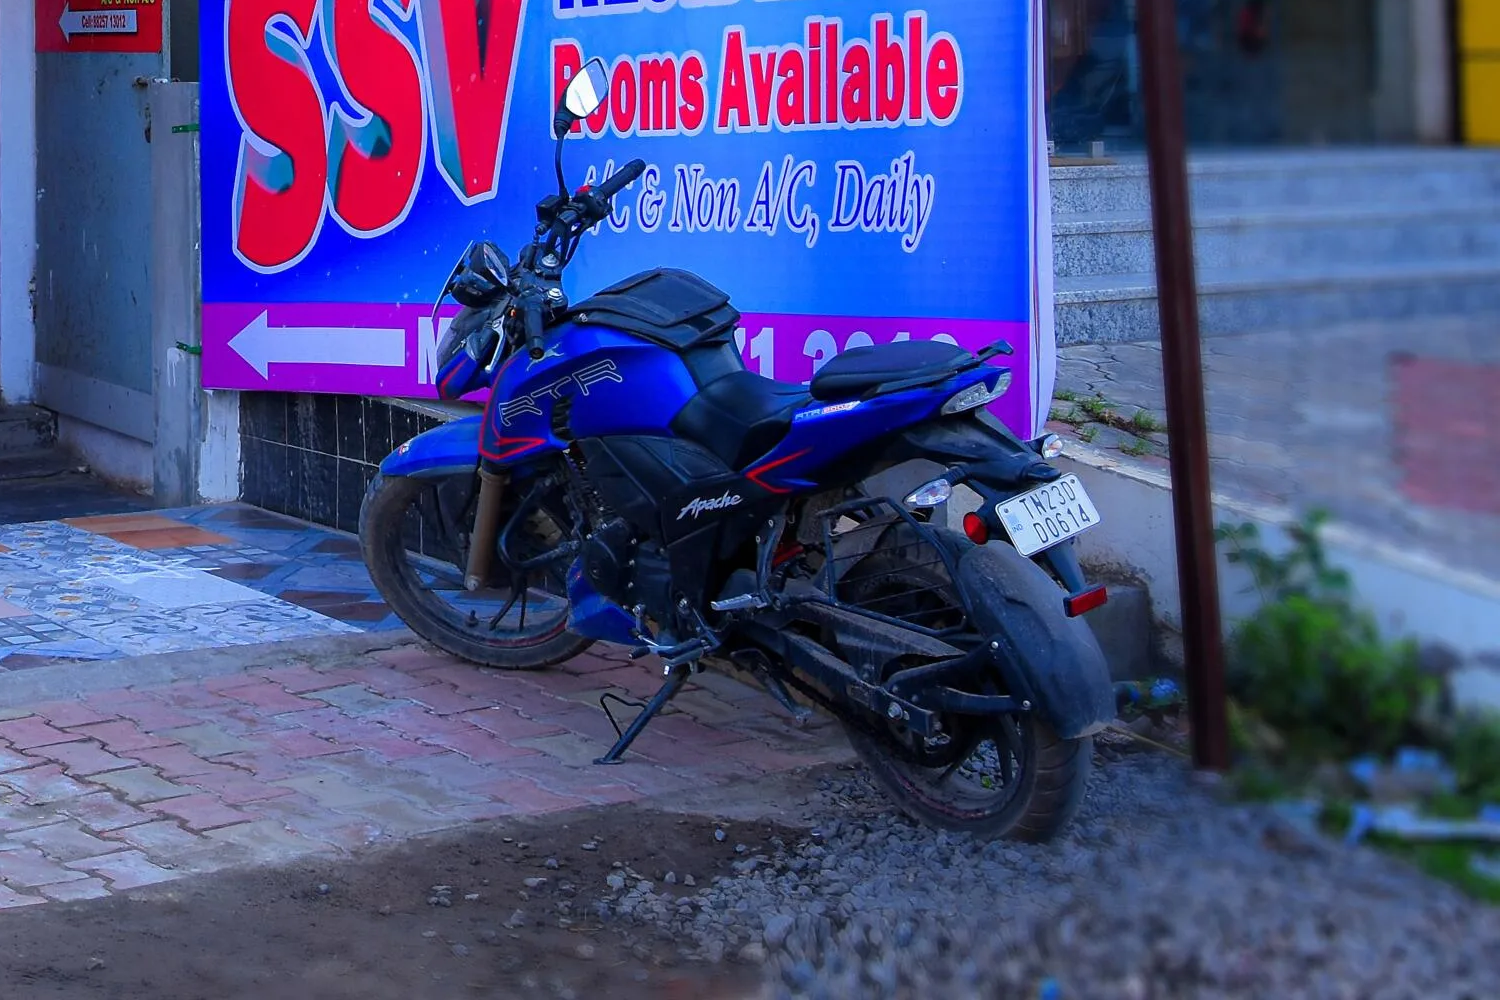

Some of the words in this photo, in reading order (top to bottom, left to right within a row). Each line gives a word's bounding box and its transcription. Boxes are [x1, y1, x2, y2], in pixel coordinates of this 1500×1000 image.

[553, 41, 706, 136] Roms
[716, 13, 961, 129] Available
[637, 161, 665, 233] &
[669, 158, 740, 234] Non
[827, 150, 935, 253] Daily
[676, 489, 743, 520] Apache
[1019, 481, 1076, 520] TN23D
